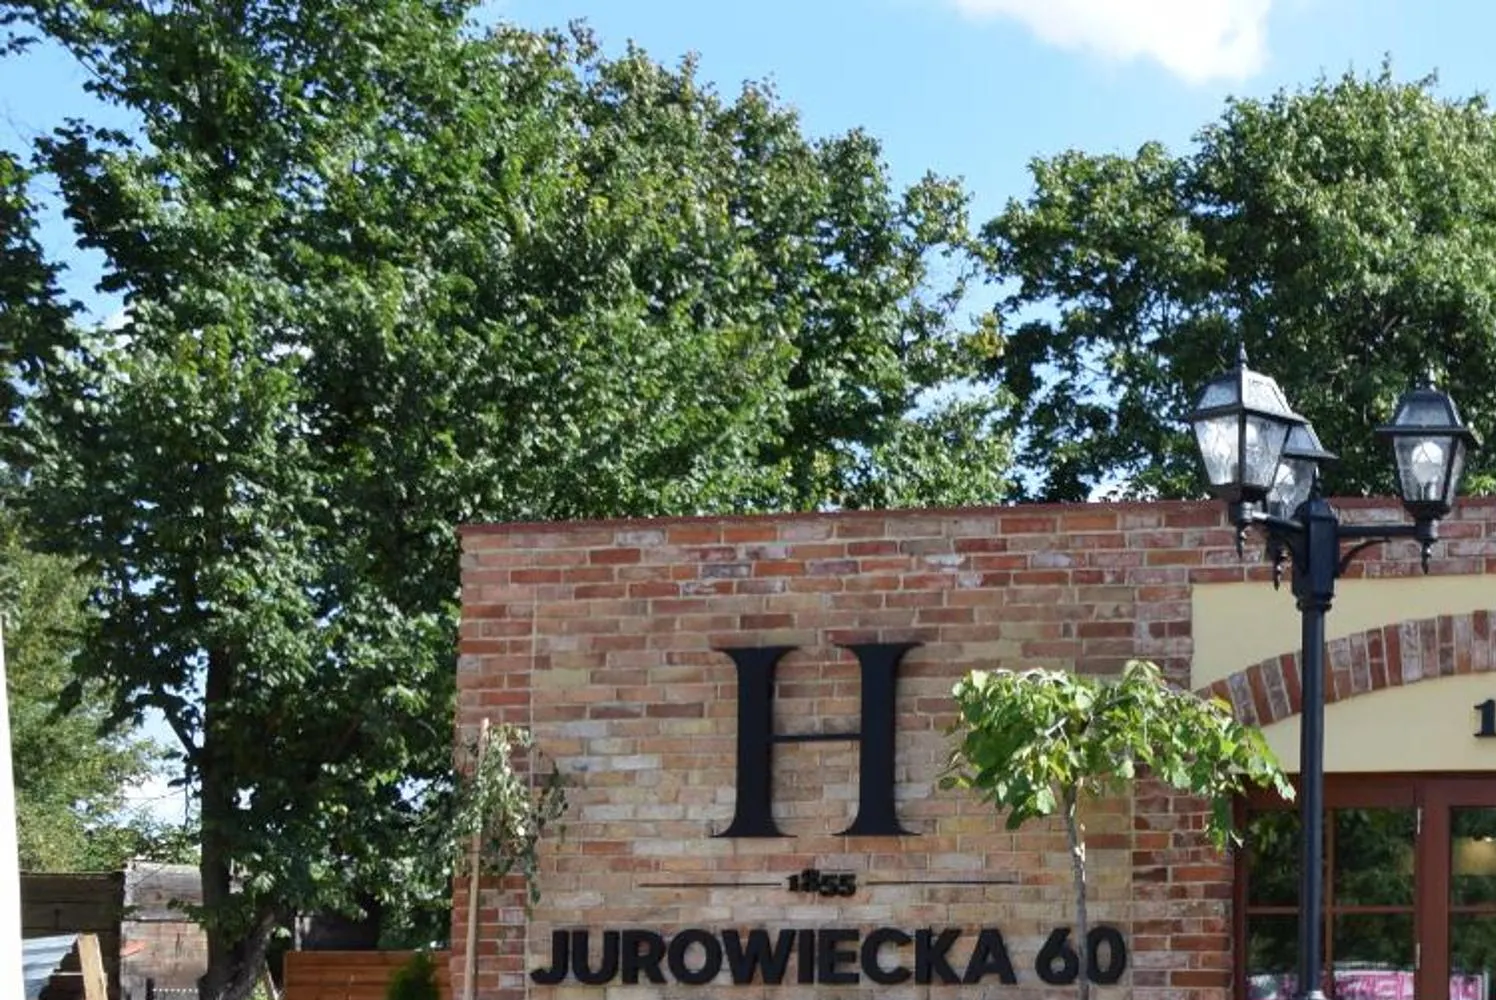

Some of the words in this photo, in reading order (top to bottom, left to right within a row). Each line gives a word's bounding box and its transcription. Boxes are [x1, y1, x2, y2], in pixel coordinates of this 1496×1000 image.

[710, 640, 926, 839] H
[786, 868, 857, 897] 1855
[530, 926, 1018, 986] JUROWIECKA
[1035, 924, 1127, 986] 60
